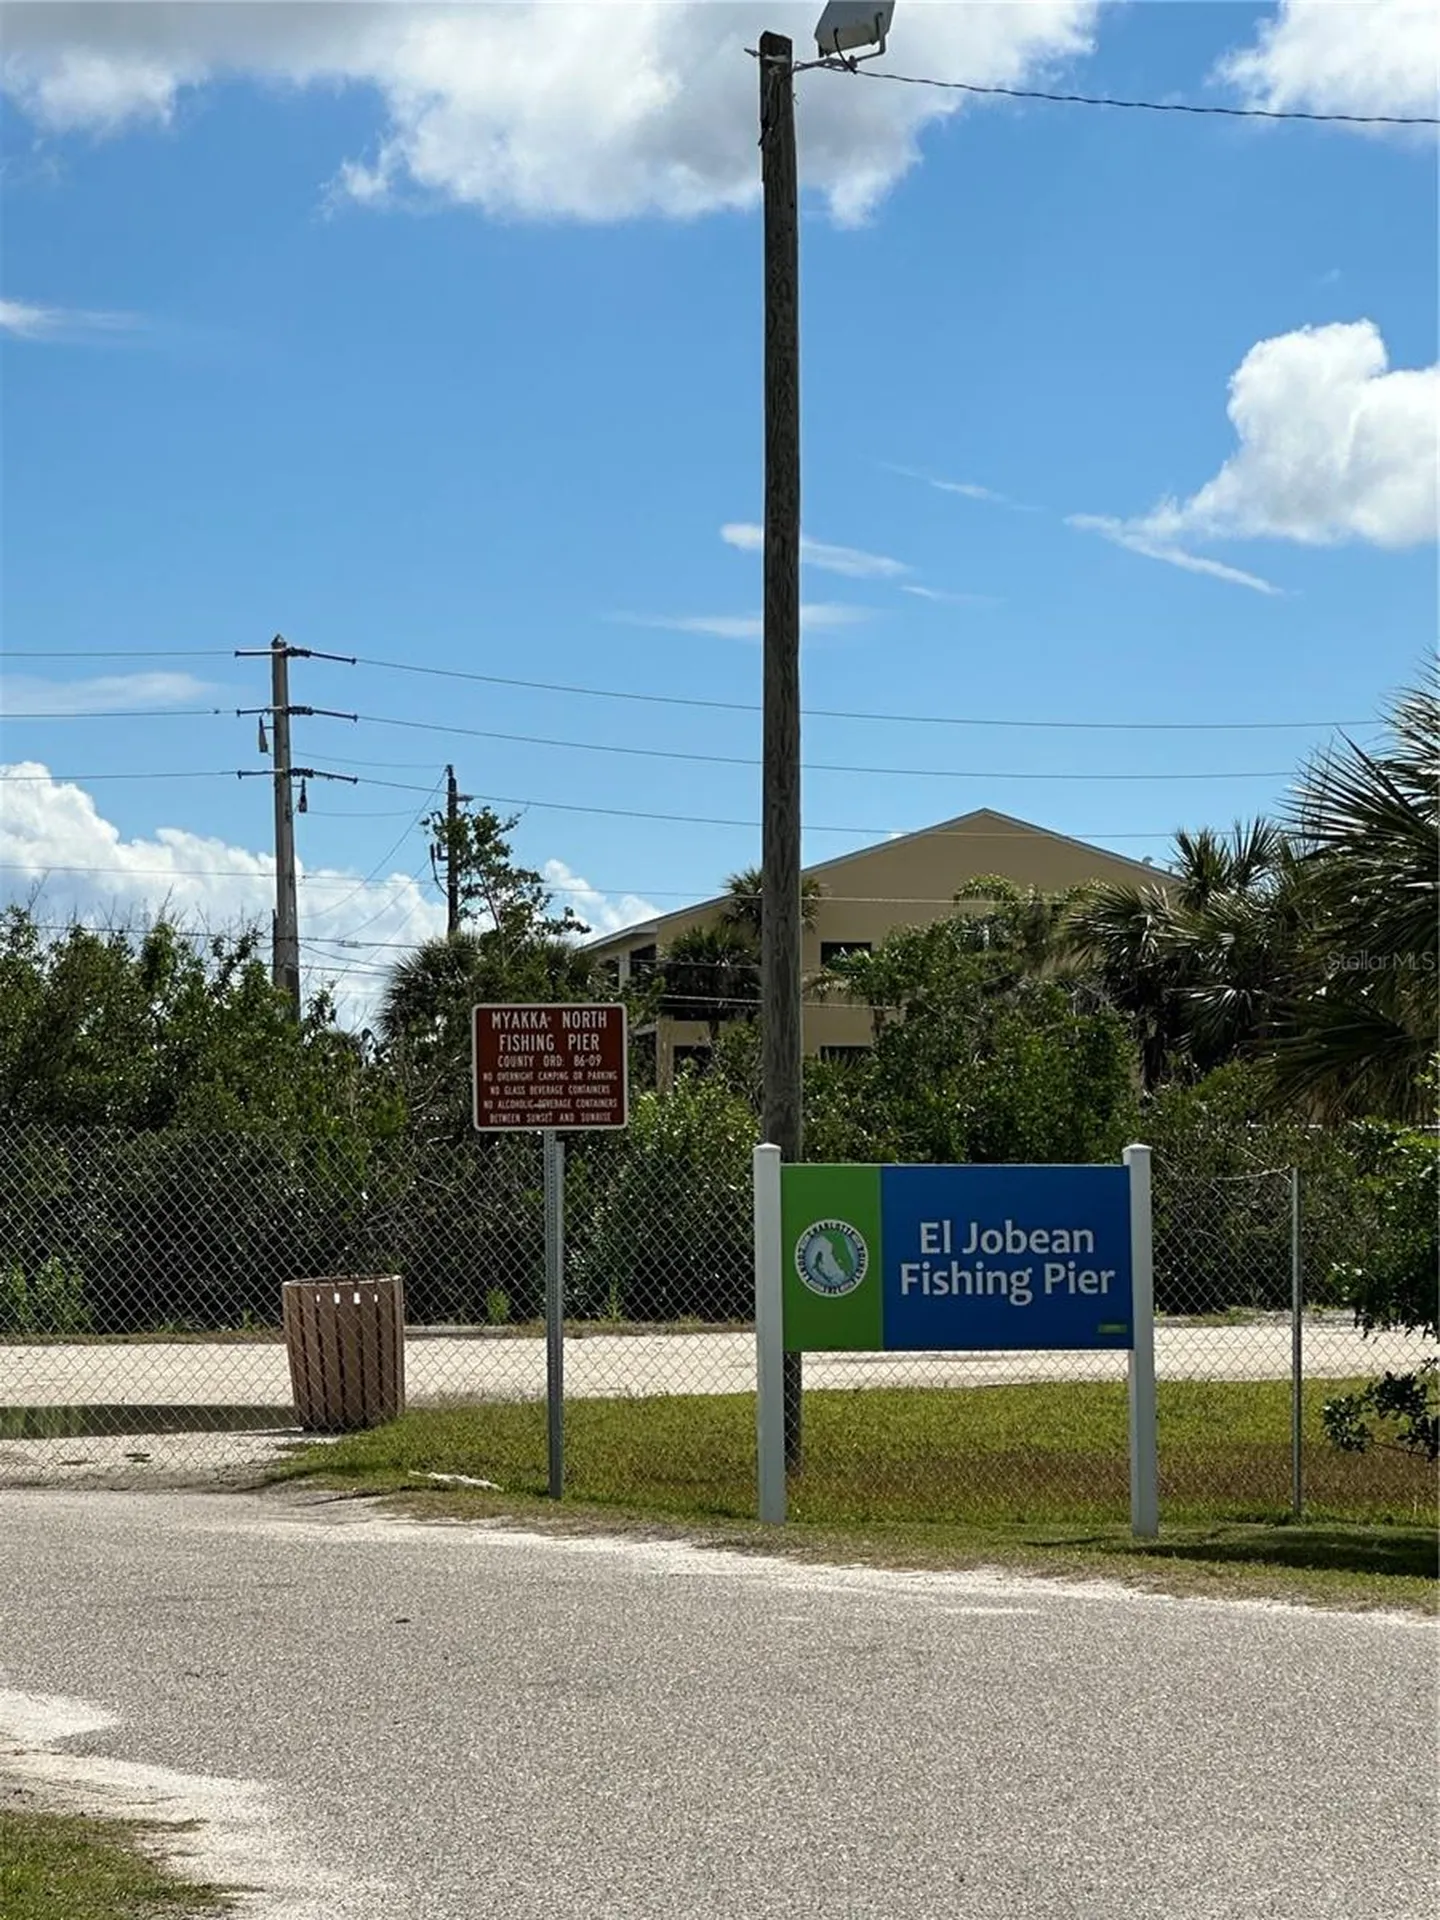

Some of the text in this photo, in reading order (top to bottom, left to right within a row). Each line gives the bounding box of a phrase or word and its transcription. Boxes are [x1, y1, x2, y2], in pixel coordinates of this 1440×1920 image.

[491, 1010, 608, 1029] MYAKKA NORTH
[499, 1033, 600, 1052] FISHING PIER
[497, 1055, 535, 1068] COUNTY
[482, 1070, 618, 1082] NO OVERNIGHT CAMPING OR PARKING
[490, 1085, 611, 1096] NO GLASS BEVERAGE CONTAINERS
[483, 1100, 494, 1109] NO
[497, 1099, 535, 1109] ALCOHOLIC
[575, 1098, 618, 1109] CONTAINERS
[489, 1112, 612, 1124] BETWEEN SUNSET AND SUNRISE
[920, 1219, 1094, 1254] El Jobean
[900, 1261, 1116, 1306] Fishing Pier
